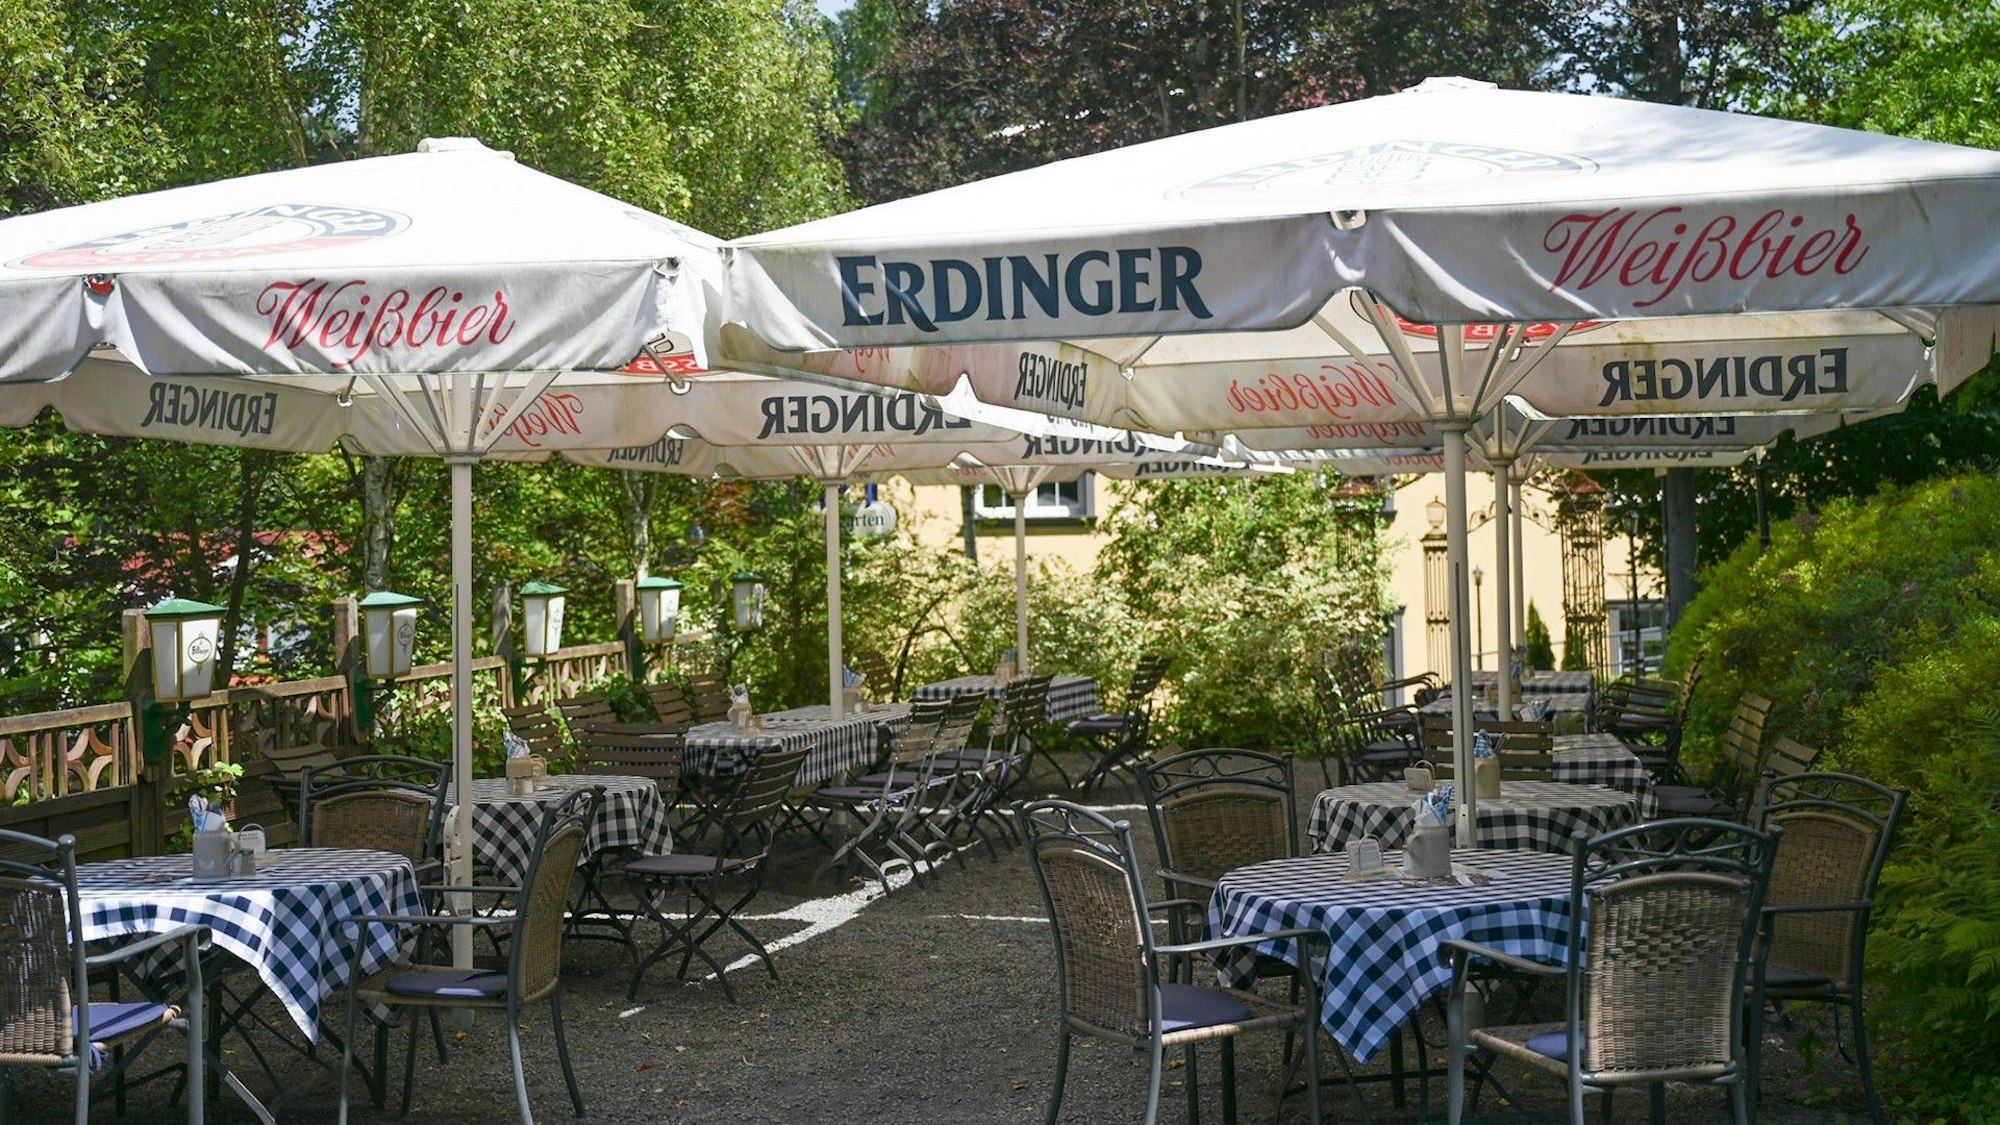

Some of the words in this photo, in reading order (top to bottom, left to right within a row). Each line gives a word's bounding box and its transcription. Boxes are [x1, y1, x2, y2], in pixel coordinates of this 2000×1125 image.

[836, 246, 1214, 333] ERDINGER
[1543, 206, 1870, 308] Weißbier
[256, 278, 516, 368] Weißbier
[846, 514, 885, 529] arten
